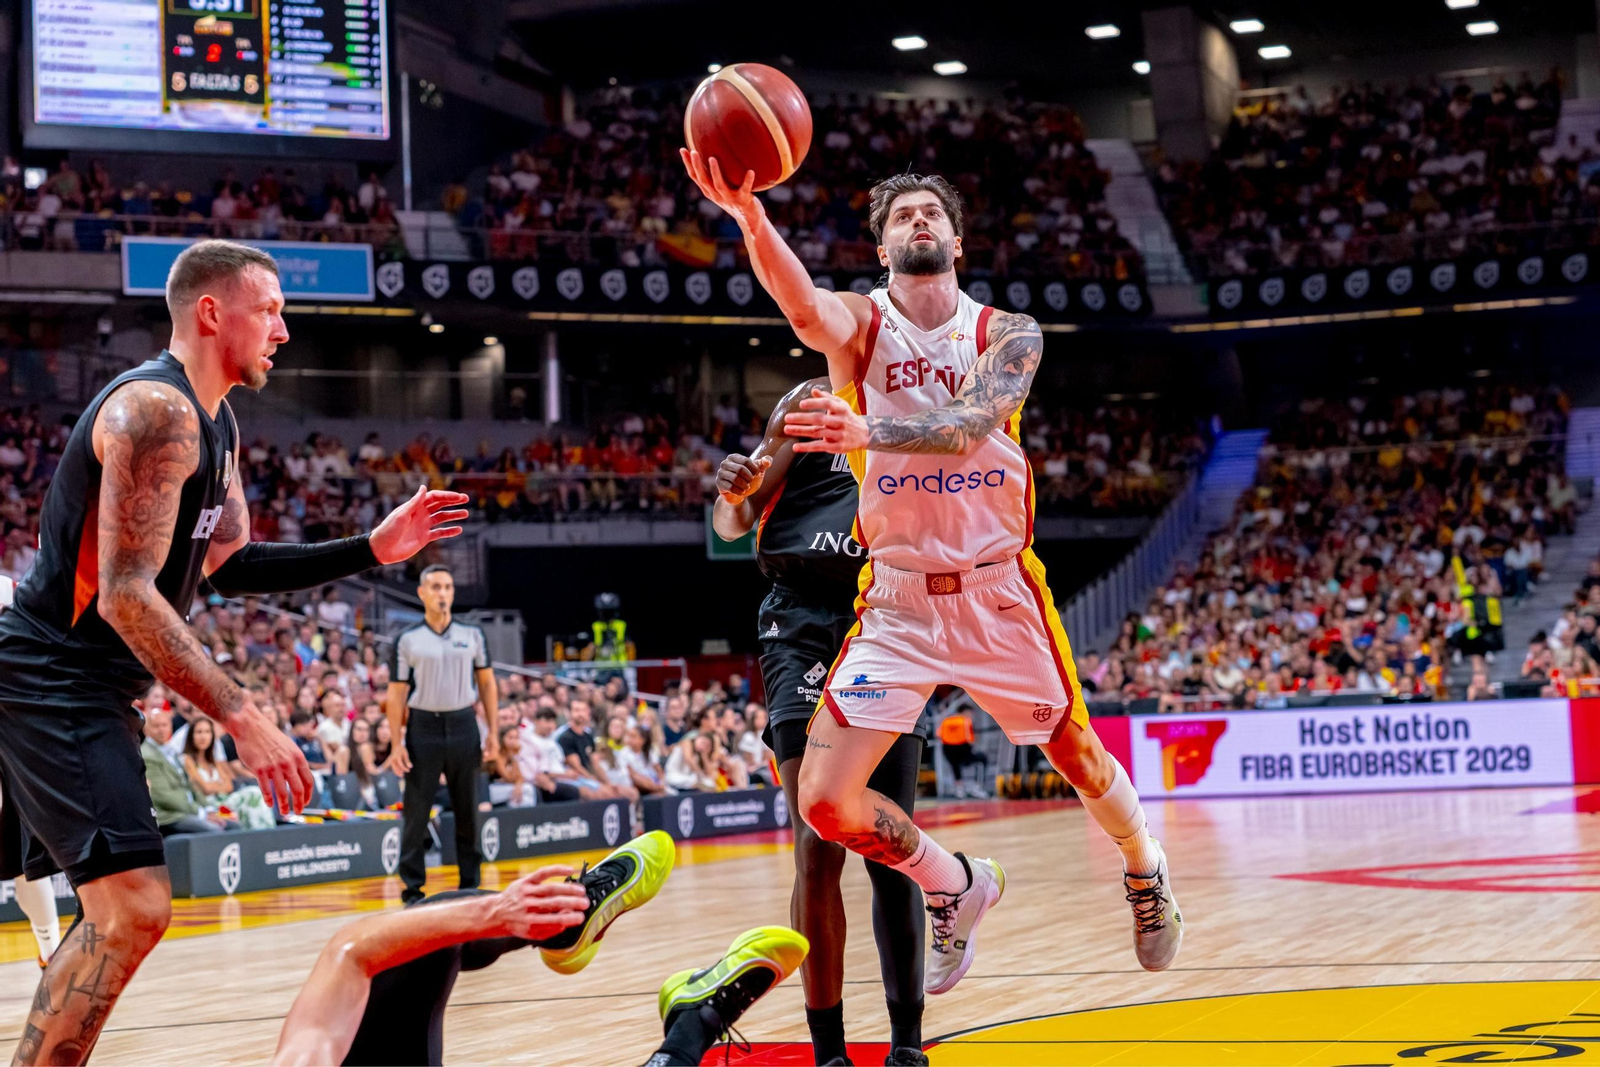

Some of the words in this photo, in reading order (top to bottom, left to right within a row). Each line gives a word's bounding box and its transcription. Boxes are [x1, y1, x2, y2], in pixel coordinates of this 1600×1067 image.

[877, 468, 1005, 495] endesa
[808, 531, 864, 557] ING
[1300, 716, 1365, 746] Host
[1374, 713, 1470, 743] Nation
[1241, 754, 1294, 781] FIBA
[1301, 749, 1459, 779] EUROBASKET
[1466, 745, 1532, 773] 2029
